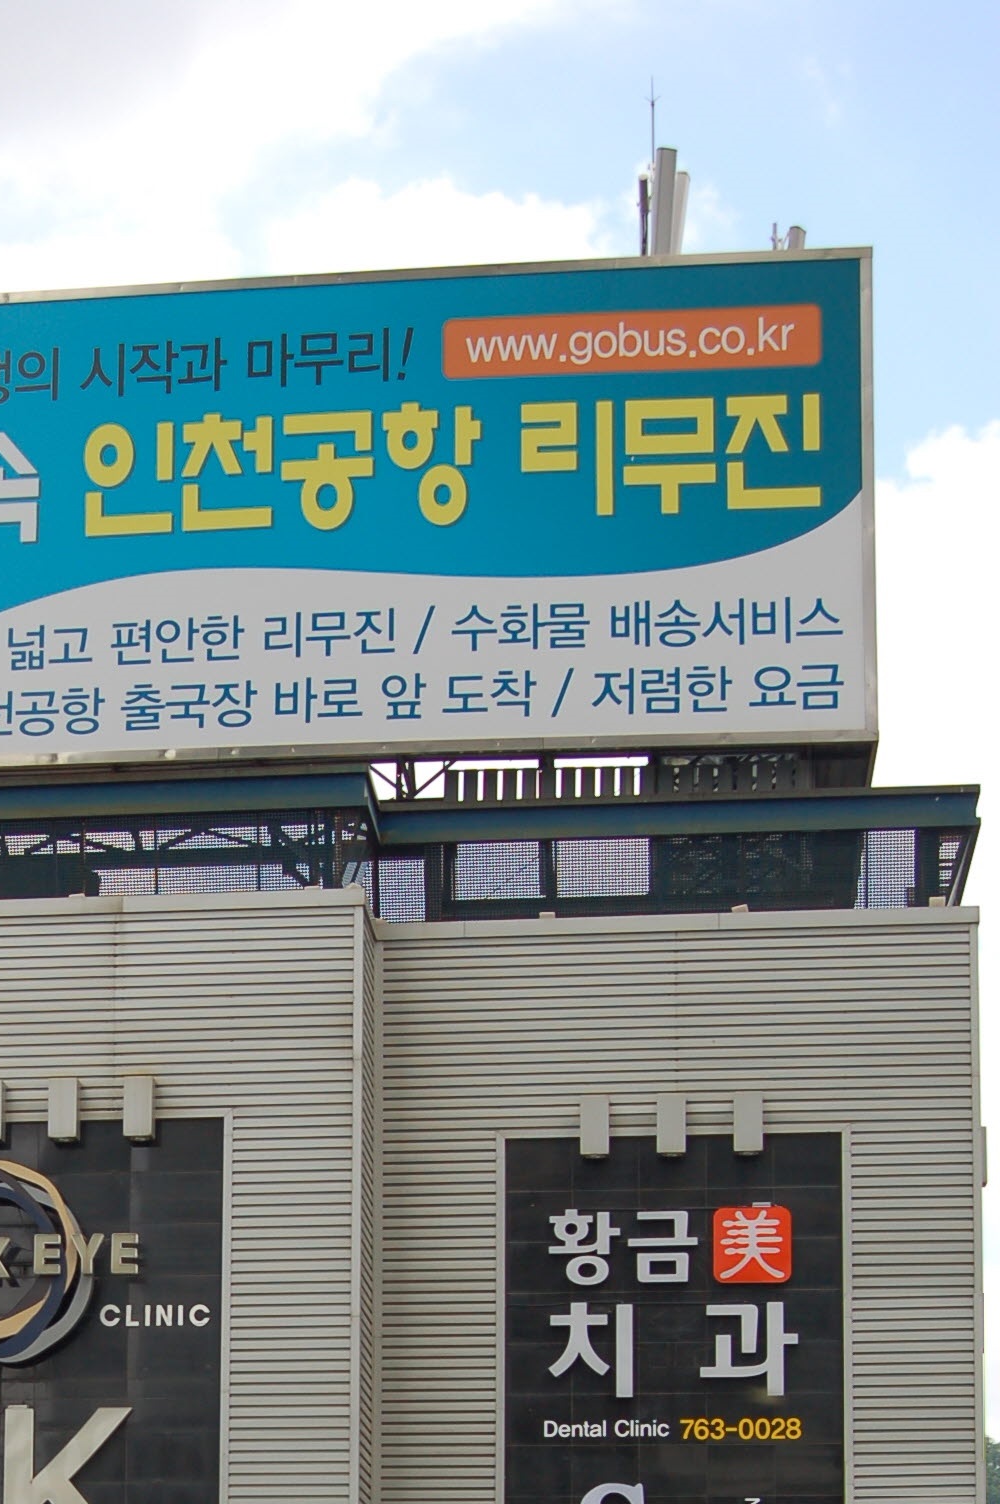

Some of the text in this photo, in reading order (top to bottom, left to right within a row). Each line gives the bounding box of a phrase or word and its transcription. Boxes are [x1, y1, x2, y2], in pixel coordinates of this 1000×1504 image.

[80, 337, 228, 398] 시작과
[247, 326, 414, 388] 마무리!
[466, 316, 796, 365] www.gobus.co.kr
[84, 402, 482, 538] 인천공항
[520, 393, 823, 516] 리무진
[7, 625, 94, 670] 넓고
[110, 615, 245, 666] 편안한
[263, 607, 398, 658] 리무진
[450, 602, 591, 652] 수화물
[610, 596, 844, 647] 배송서비스
[120, 679, 257, 732] 출국장
[274, 675, 364, 723] 바로
[382, 673, 427, 720] 앞
[441, 669, 538, 718] 도착
[591, 664, 733, 715] 저렴한
[748, 662, 844, 710] 요금
[548, 1208, 699, 1286] 황금
[99, 1304, 212, 1328] CLINIC
[543, 1417, 802, 1440] Dental Clinic 763-0028
